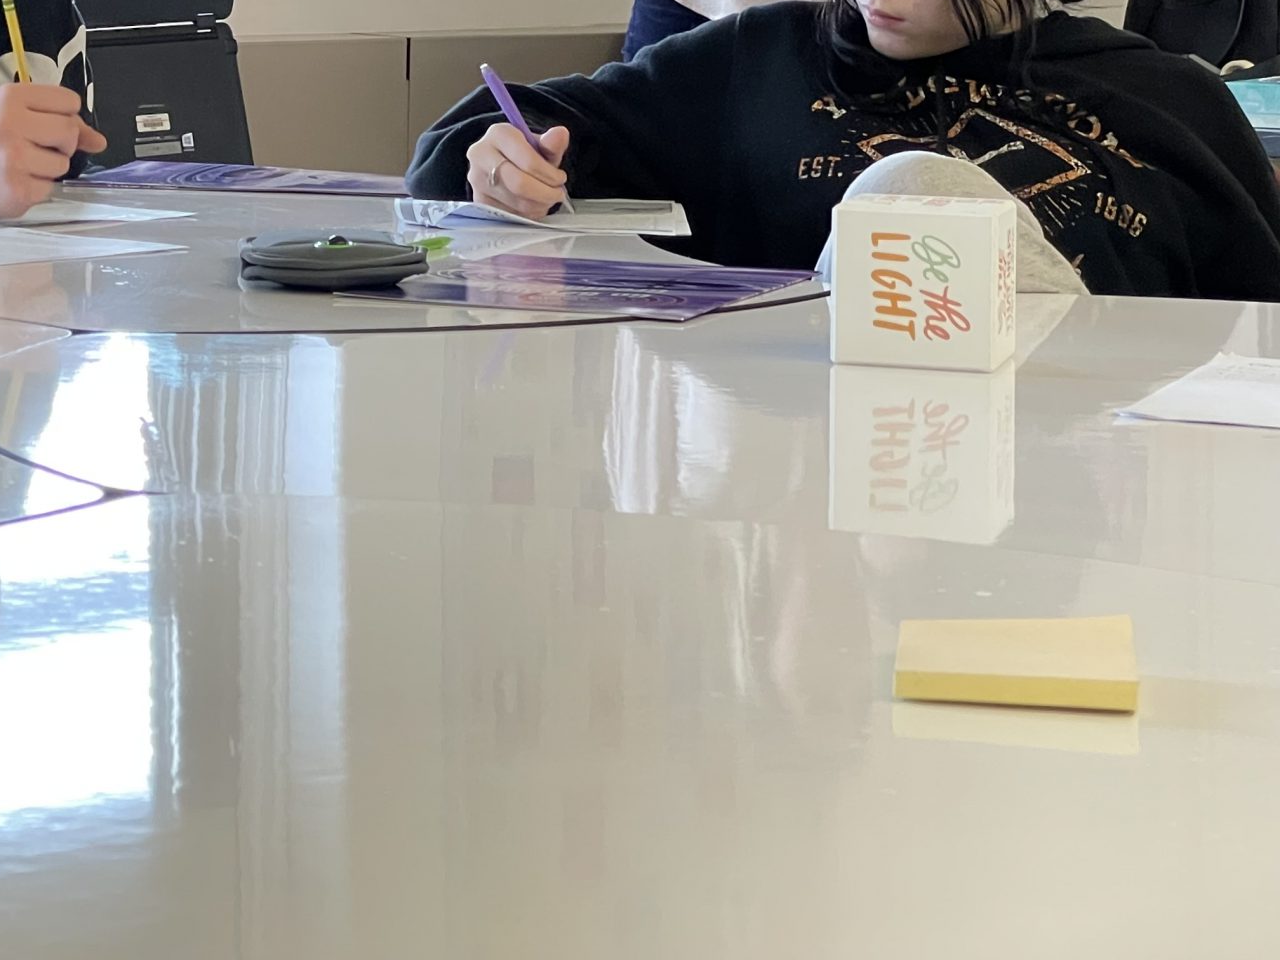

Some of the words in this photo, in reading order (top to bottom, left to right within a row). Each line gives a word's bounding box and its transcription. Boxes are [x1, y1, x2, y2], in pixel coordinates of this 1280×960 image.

[798, 156, 843, 179] EST.
[911, 235, 961, 283] Be
[870, 232, 917, 341] LIGHT
[919, 286, 971, 341] the
